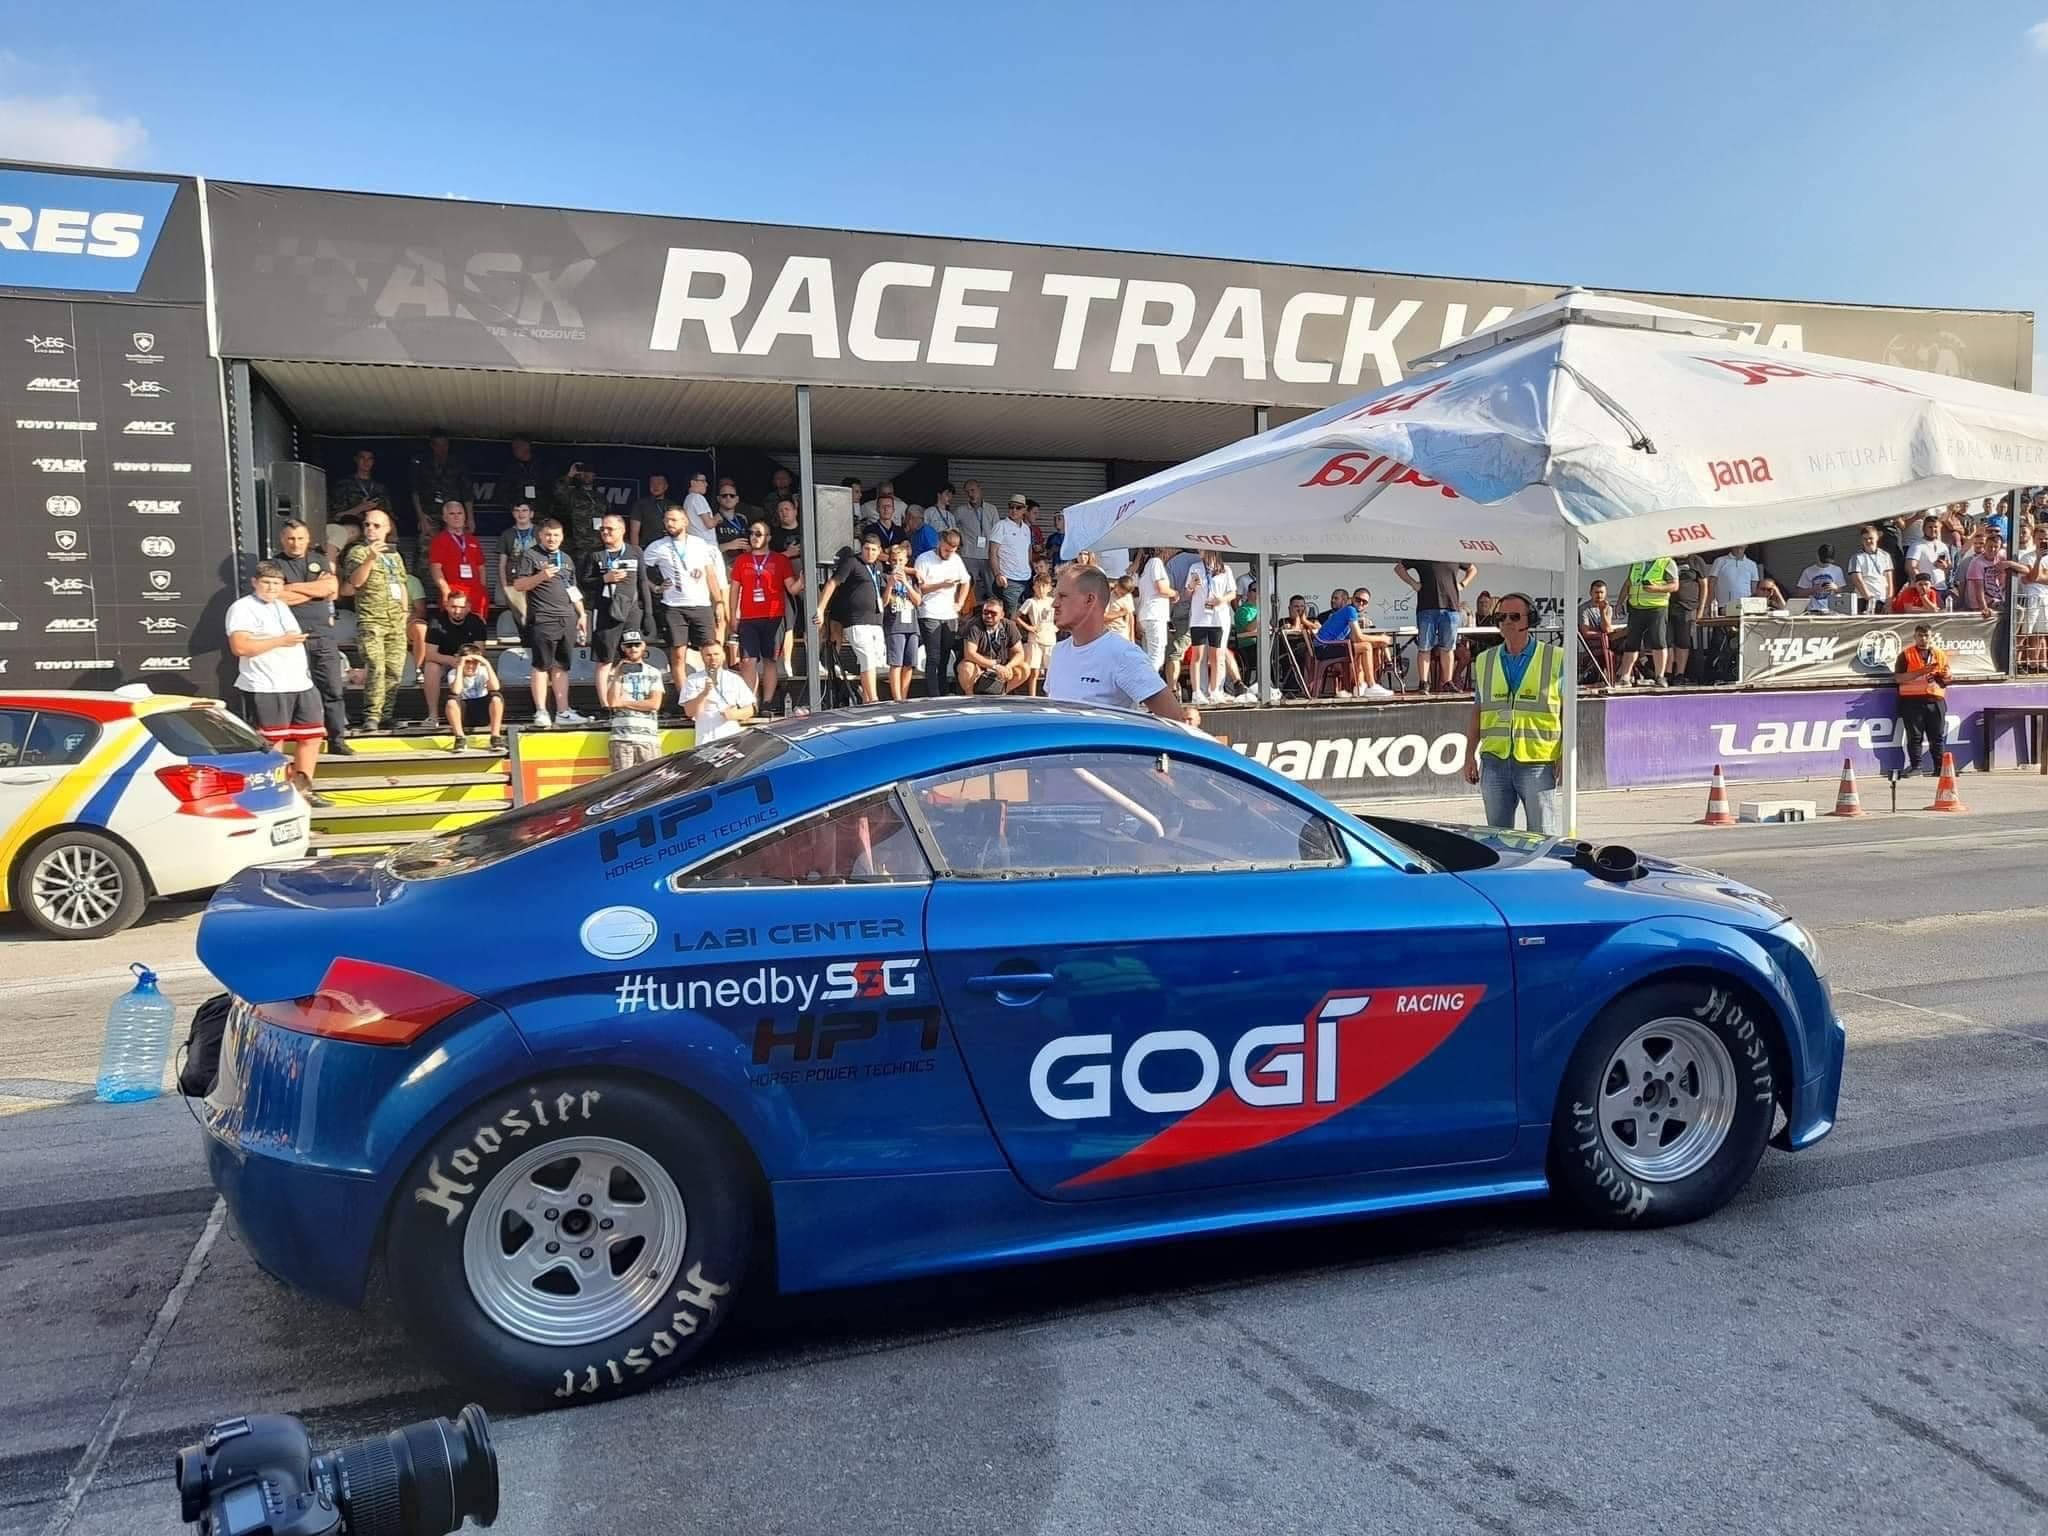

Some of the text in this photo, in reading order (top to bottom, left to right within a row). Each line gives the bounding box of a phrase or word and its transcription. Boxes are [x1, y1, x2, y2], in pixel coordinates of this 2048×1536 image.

[649, 247, 1013, 367] RACE
[1041, 273, 1424, 387] TRACK
[16, 420, 97, 431] TOYO TIRES
[40, 459, 87, 473] TASK
[137, 501, 182, 514] TASK
[1769, 637, 1839, 664] TASK
[605, 807, 778, 881] HORSE POWER TECHNICS
[673, 918, 906, 953] LABI CENTER
[1396, 992, 1465, 1013] RACING
[751, 1057, 936, 1089] HORSE POWER TECHNICS
[415, 1087, 601, 1227] Hoosier
[554, 1260, 731, 1399] Hoosier
